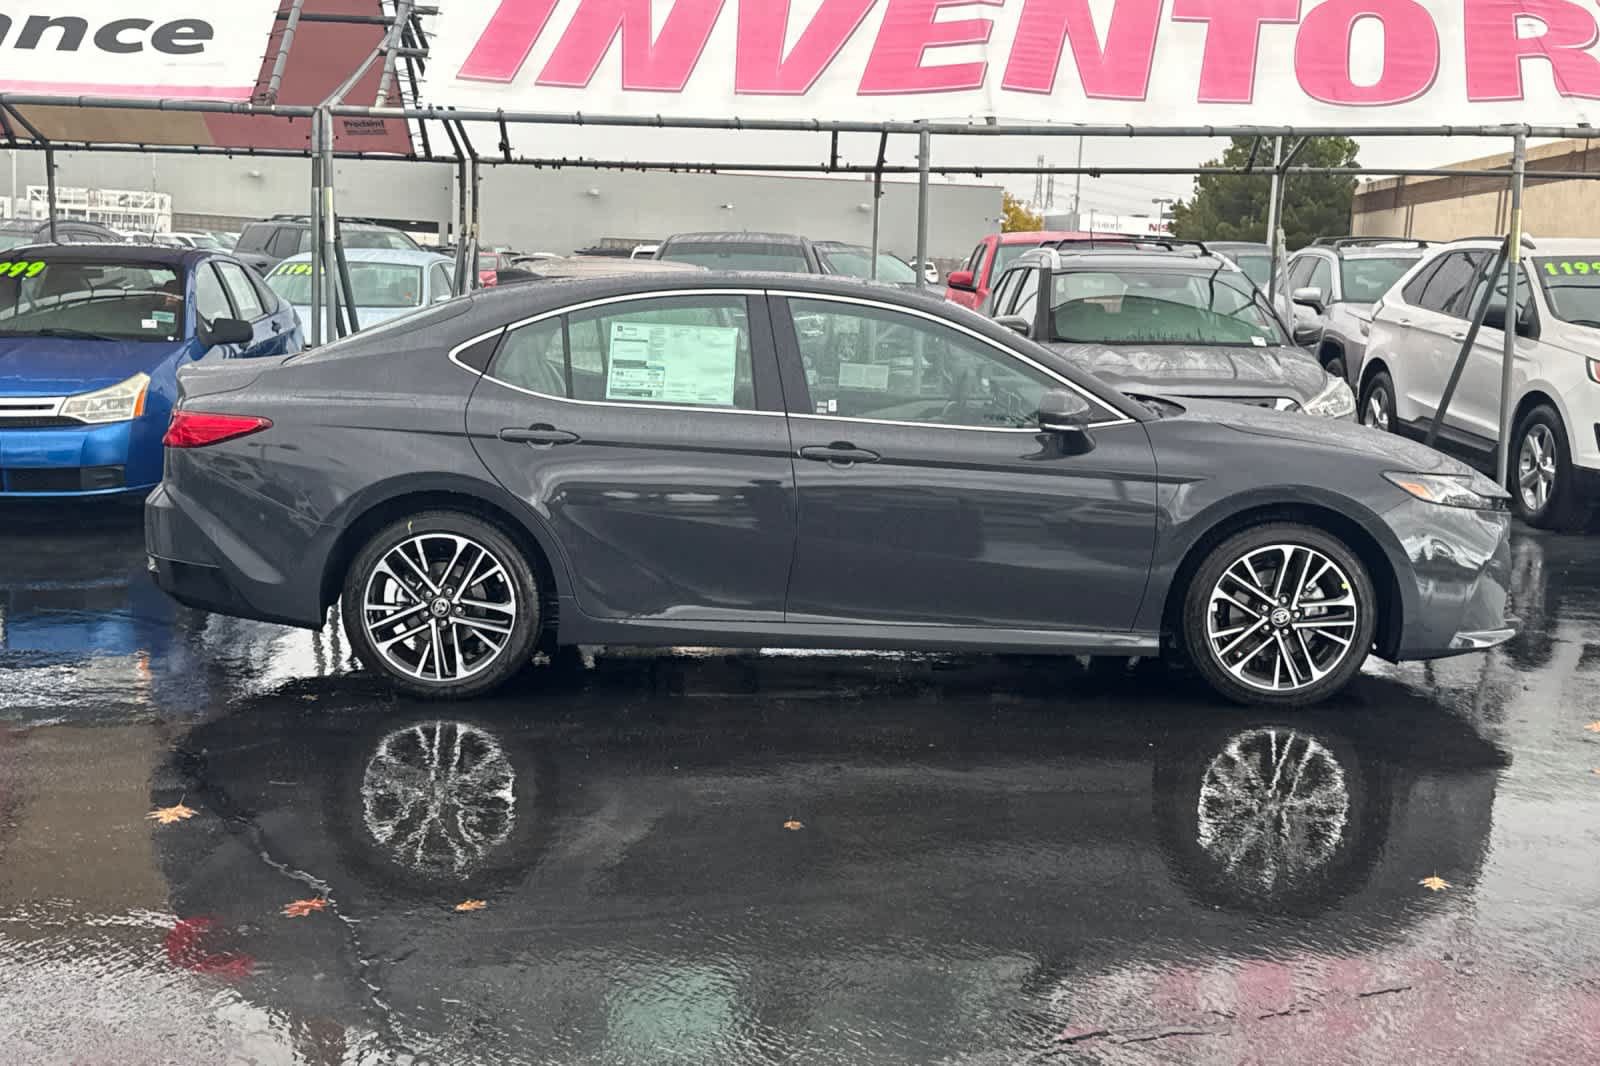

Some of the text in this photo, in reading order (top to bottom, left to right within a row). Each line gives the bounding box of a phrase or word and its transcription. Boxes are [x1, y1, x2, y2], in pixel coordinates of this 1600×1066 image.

[0, 13, 214, 54] nce
[455, 0, 1600, 106] INVENTOR
[1148, 223, 1171, 232] NIS
